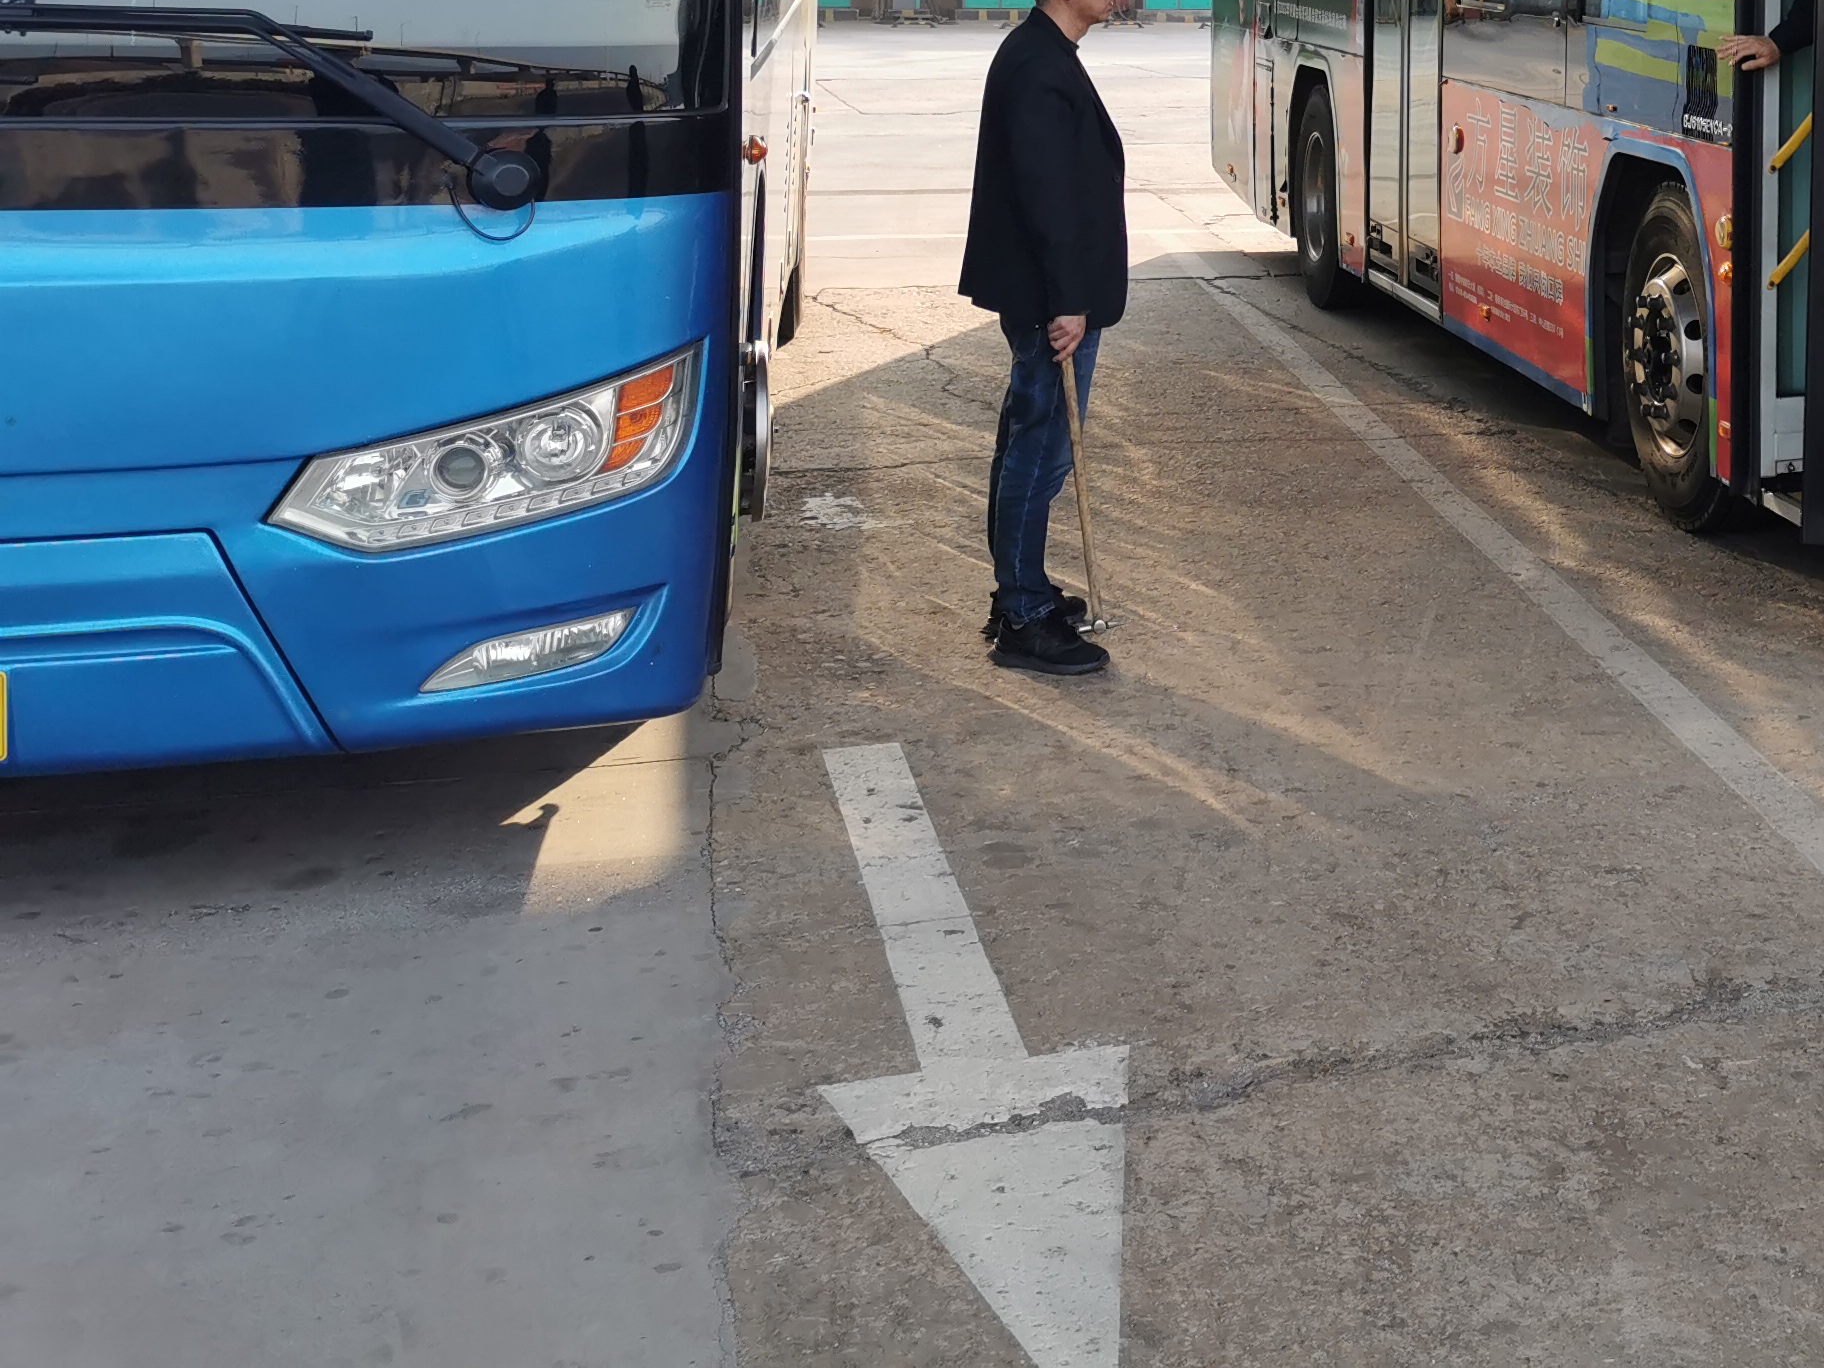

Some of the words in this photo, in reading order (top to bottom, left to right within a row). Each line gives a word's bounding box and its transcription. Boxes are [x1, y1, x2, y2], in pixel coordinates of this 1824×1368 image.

[1466, 97, 1588, 232] 方星装饰
[1465, 193, 1491, 234] FANG
[1492, 204, 1517, 246] XING
[1519, 215, 1565, 267] ZHUANG
[1566, 235, 1588, 277] SHI
